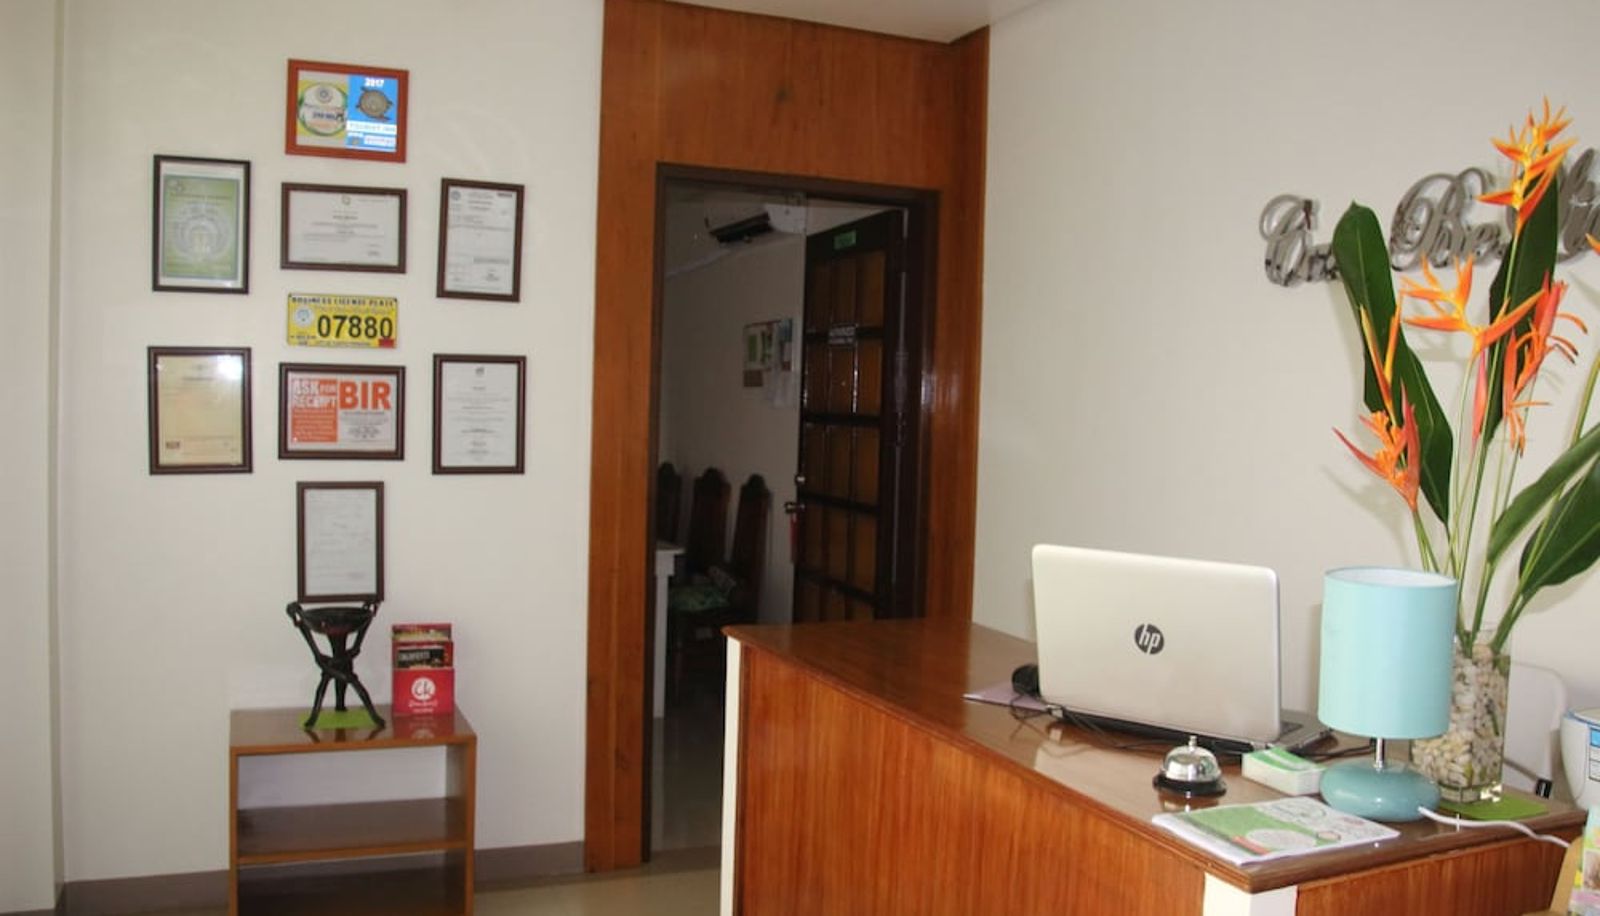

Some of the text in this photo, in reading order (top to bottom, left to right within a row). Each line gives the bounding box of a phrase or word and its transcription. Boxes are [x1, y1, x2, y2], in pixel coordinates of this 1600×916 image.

[364, 77, 385, 87] 2017
[317, 314, 393, 340] 07880
[293, 379, 319, 395] ASK
[339, 380, 392, 410] BIR
[1136, 622, 1163, 654] hp
